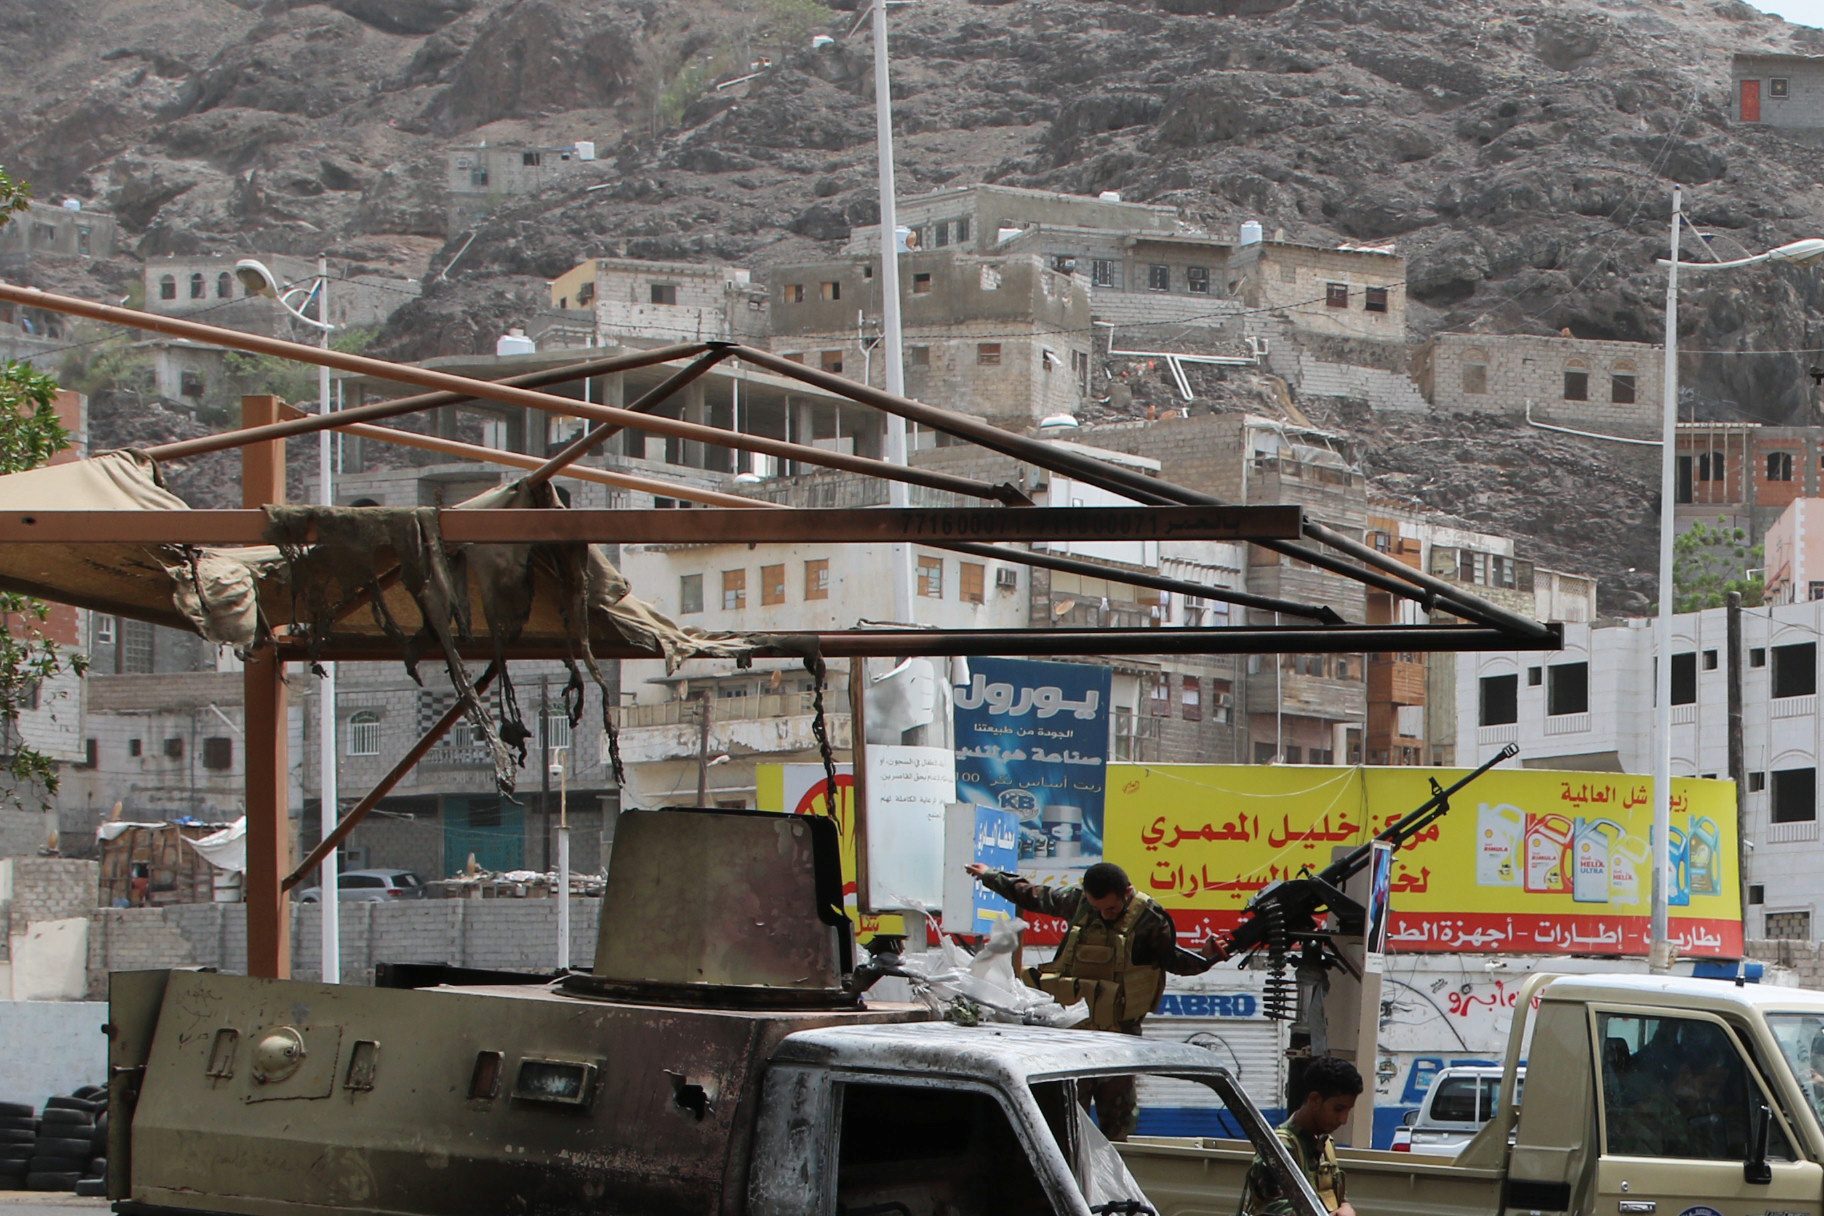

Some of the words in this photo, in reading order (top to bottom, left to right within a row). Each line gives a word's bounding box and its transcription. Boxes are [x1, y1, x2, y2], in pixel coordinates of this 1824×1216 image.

[953, 673, 1100, 720] يورول
[974, 723, 1014, 735] طبيعتنا
[1016, 727, 1035, 737] من
[1037, 729, 1074, 740] الجودة
[955, 744, 1027, 762] هولندي
[1031, 747, 1103, 766] صناعة
[1000, 793, 1035, 810] KB
[1561, 781, 1616, 808] العالمية
[1623, 784, 1648, 810] شل
[1141, 811, 1260, 851] المعمري
[1268, 811, 1361, 850] خليل
[1580, 860, 1605, 868] HELIX
[1580, 867, 1604, 875] ULTRA
[1150, 862, 1290, 899] السيارات
[1612, 873, 1633, 881] HELIX
[1440, 917, 1513, 949] أجهزة
[1534, 921, 1623, 950] إطارات
[1153, 993, 1257, 1017] ABRO
